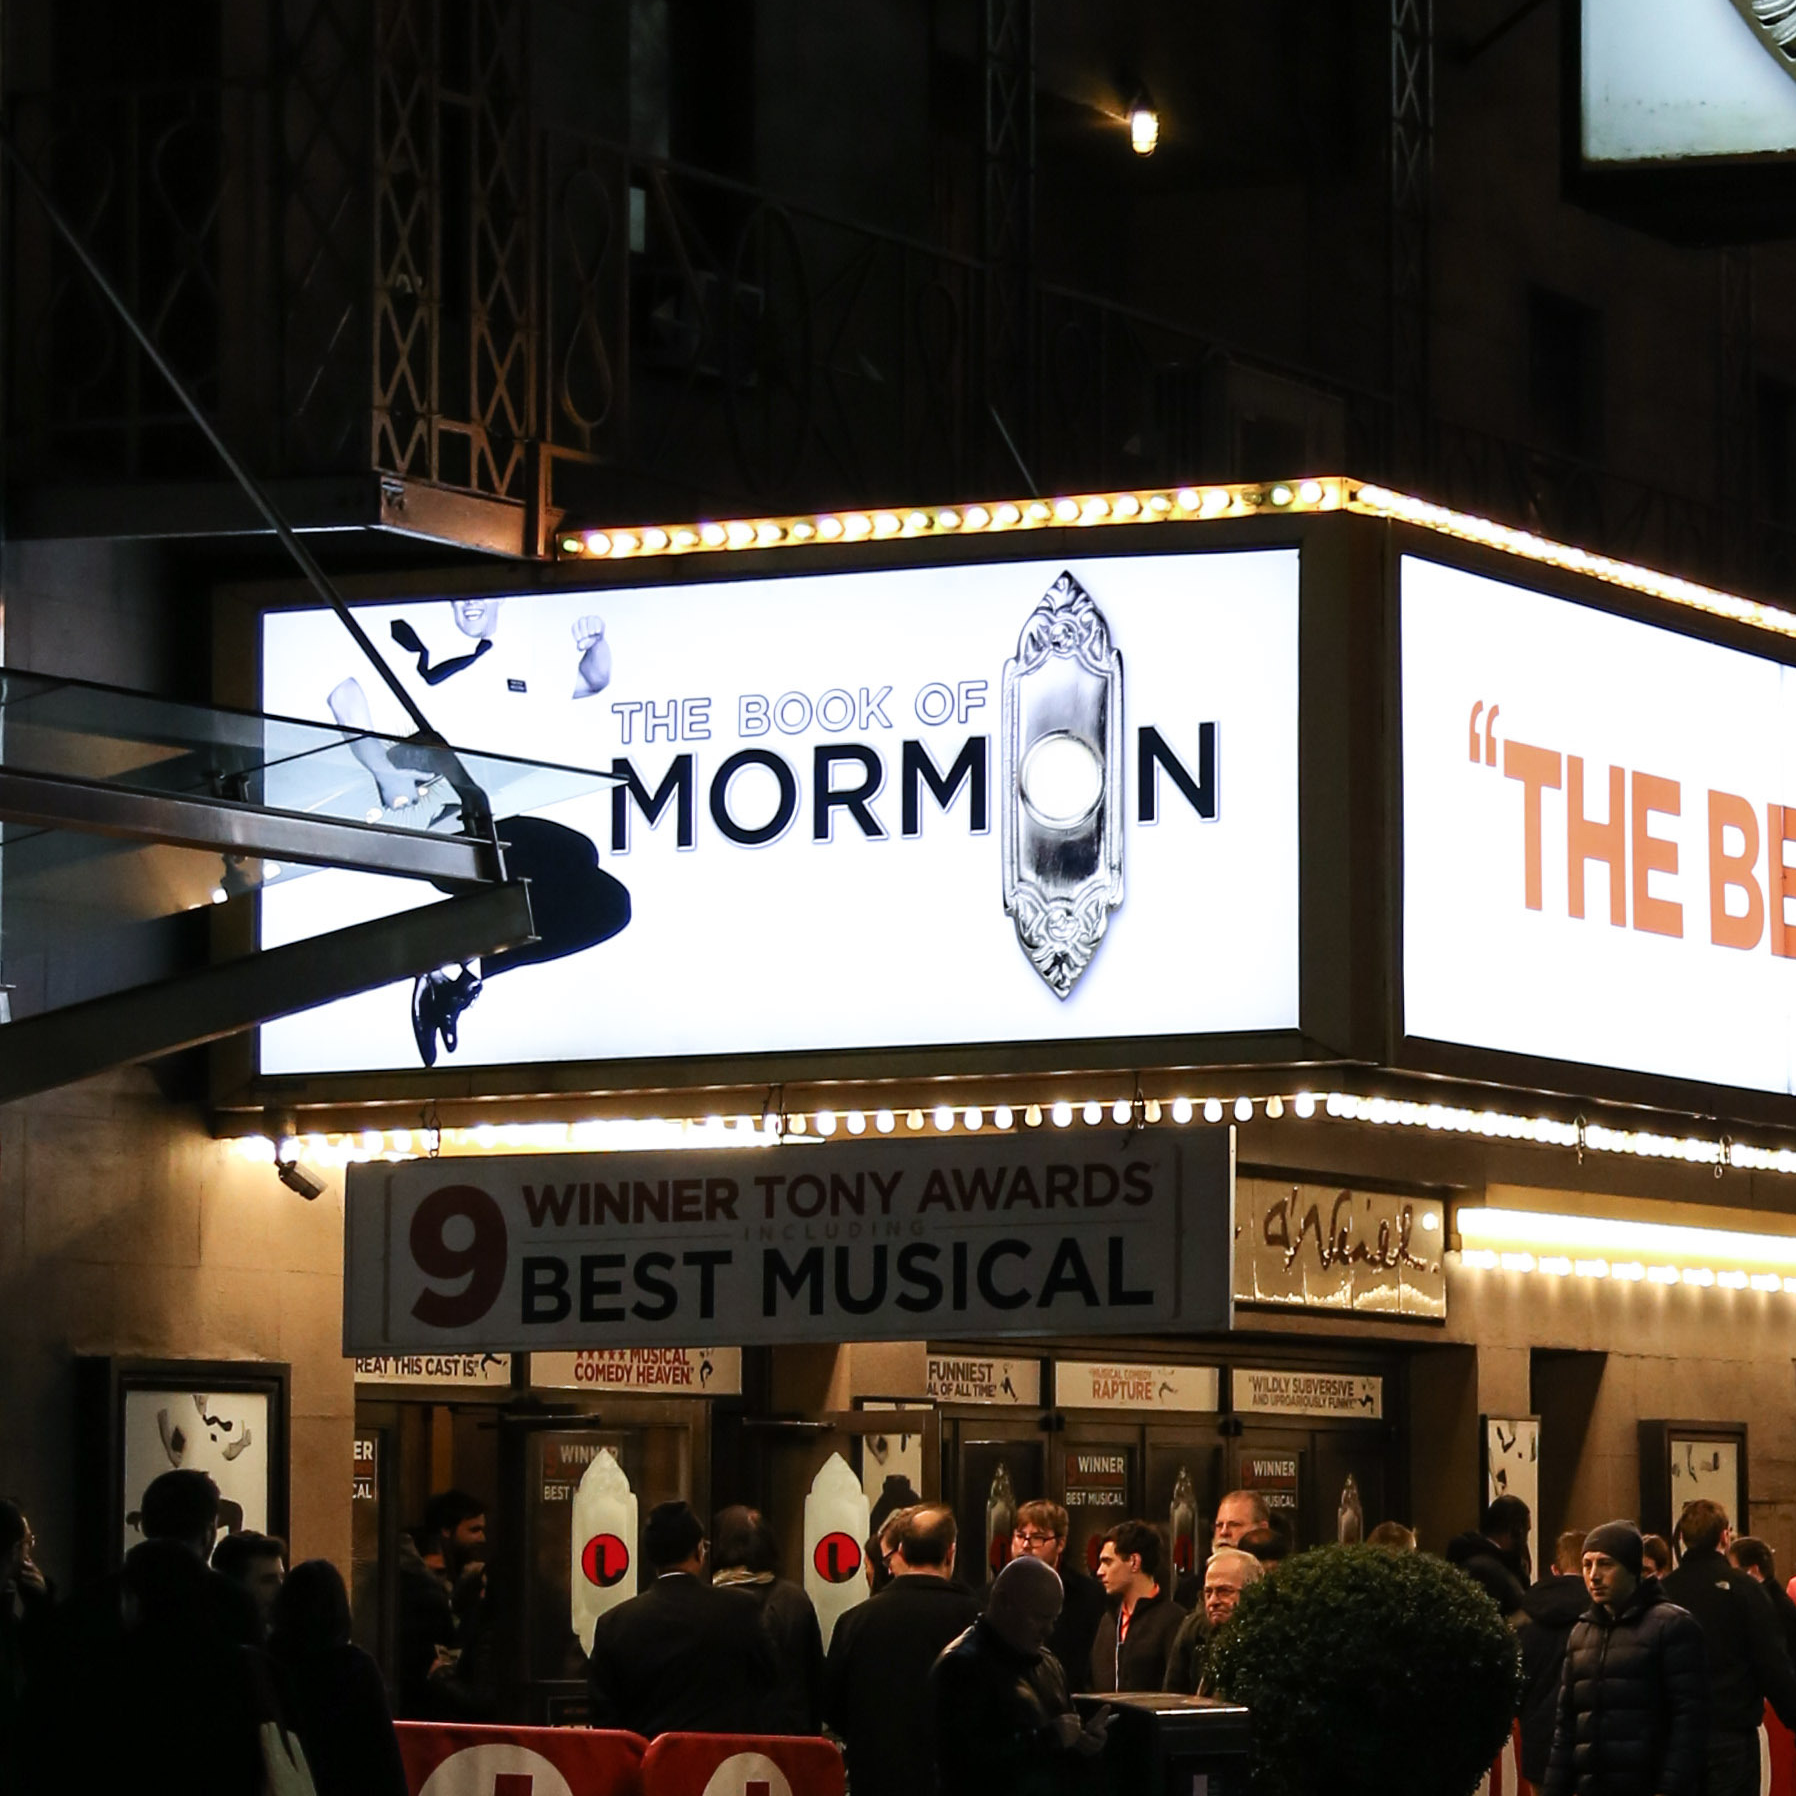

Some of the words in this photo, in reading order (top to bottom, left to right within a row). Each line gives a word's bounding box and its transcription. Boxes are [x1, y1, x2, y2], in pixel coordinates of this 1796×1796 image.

[611, 696, 711, 744] THE
[738, 685, 893, 737] BOOK
[914, 679, 988, 726] OF
[522, 1178, 739, 1229] WINNER
[755, 1171, 905, 1220] TONY
[743, 1220, 927, 1242] INCLUDING
[409, 1183, 510, 1330] 9
[521, 1250, 733, 1325] BEST
[761, 1237, 1156, 1318] MUSICAL
[630, 1347, 690, 1365] MUSICAL
[355, 1358, 391, 1375] REAT
[394, 1358, 423, 1376] THIS
[425, 1359, 459, 1377] CAST
[574, 1363, 632, 1383] COMEDY
[928, 1361, 993, 1382] FUNNIEST
[941, 1383, 953, 1396] OF
[956, 1384, 973, 1397] ALL
[1292, 1377, 1354, 1397] SUBVERSIVE
[560, 1445, 619, 1464] WINNR
[1078, 1455, 1124, 1474] WINNER
[1253, 1460, 1296, 1477] WINNER
[544, 1485, 571, 1501] BEST
[1066, 1491, 1087, 1505] BEST
[1088, 1491, 1124, 1506] MUSICAL
